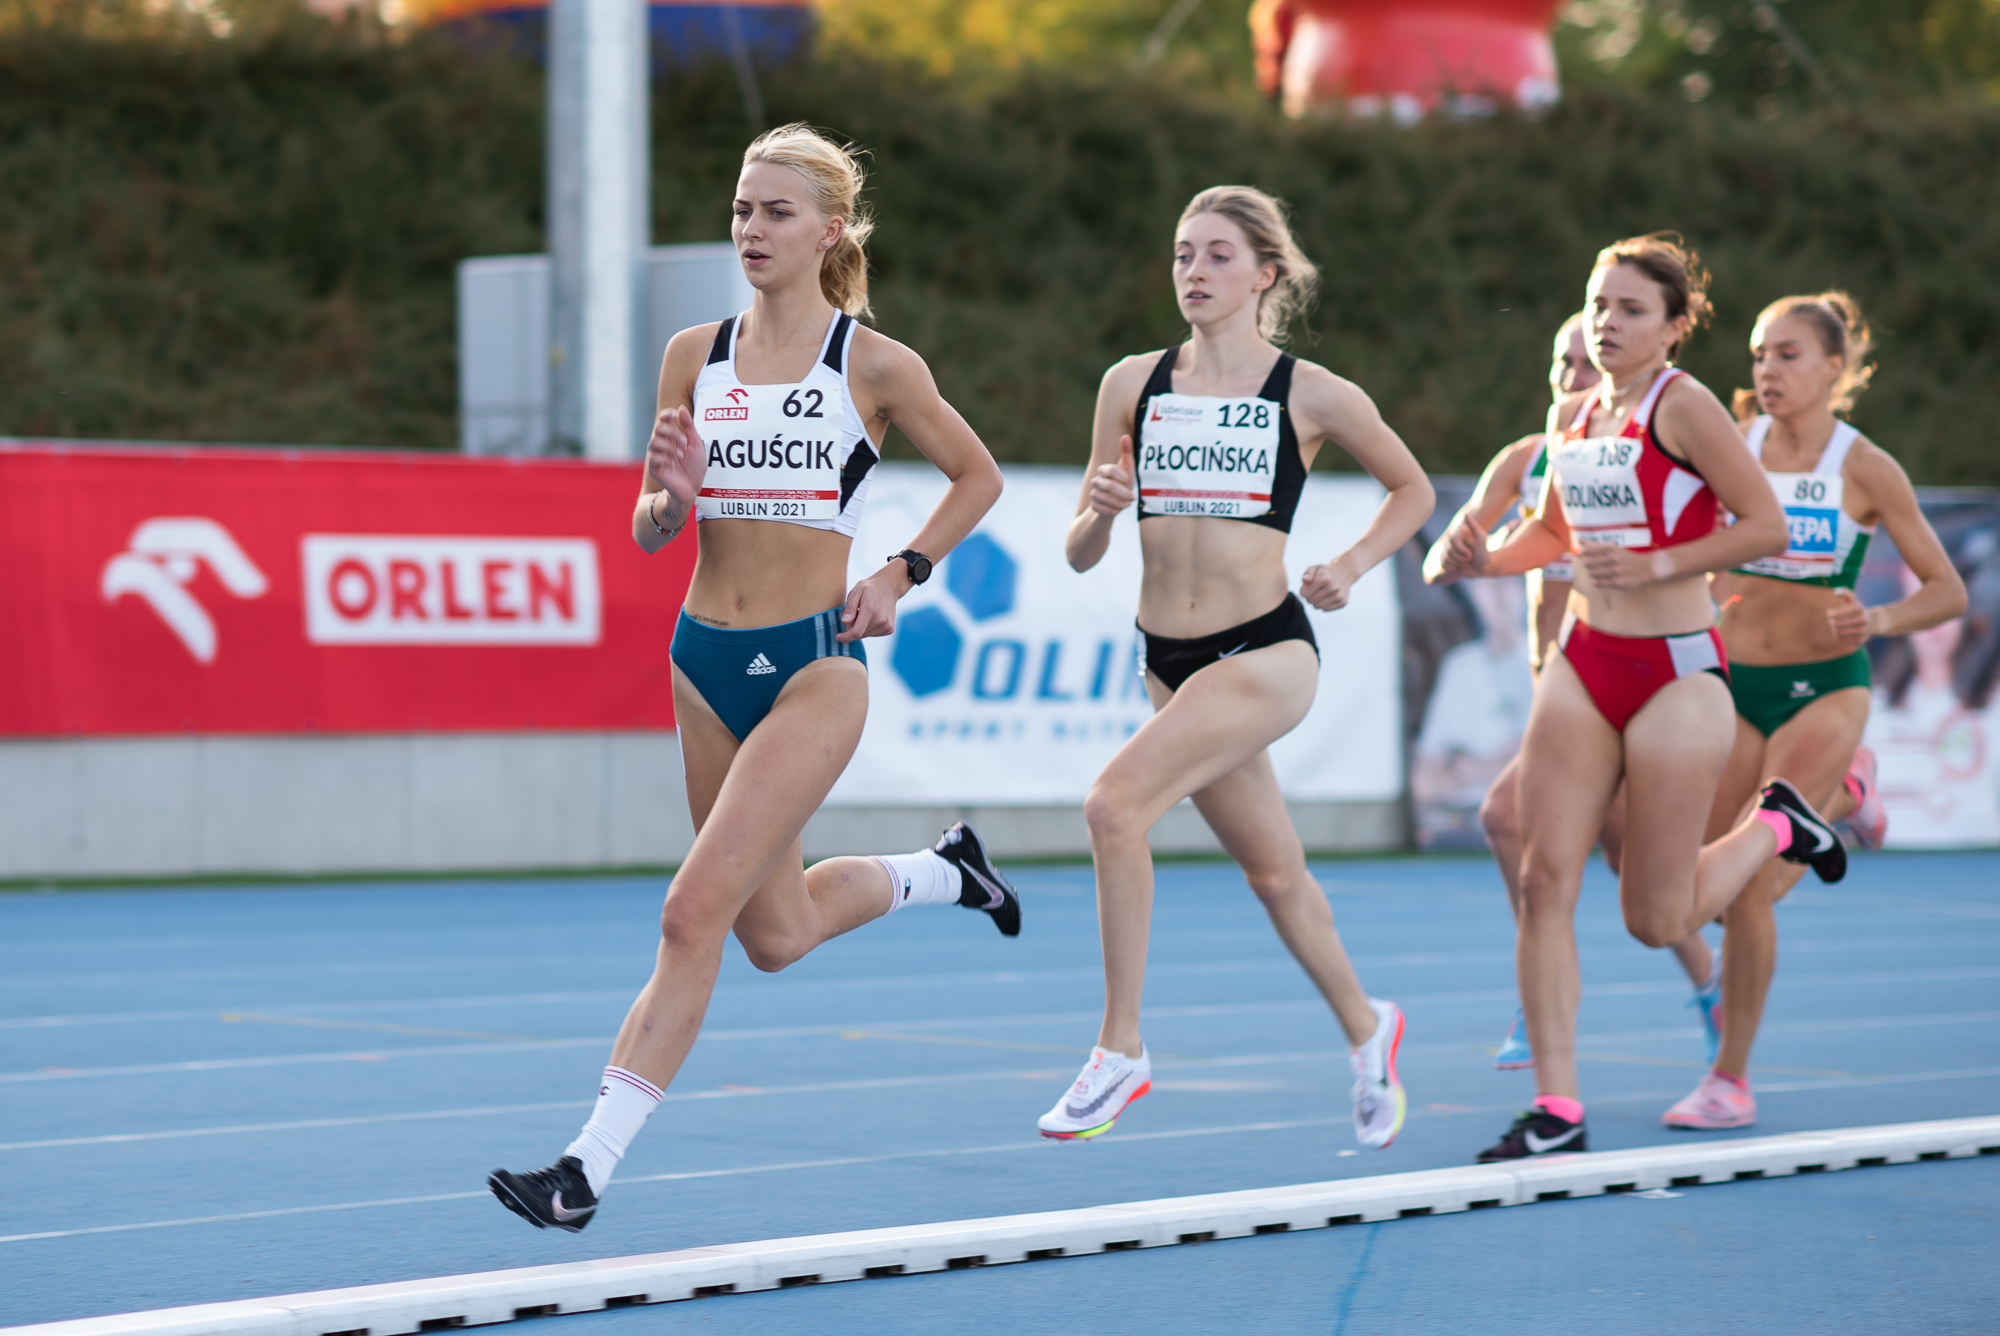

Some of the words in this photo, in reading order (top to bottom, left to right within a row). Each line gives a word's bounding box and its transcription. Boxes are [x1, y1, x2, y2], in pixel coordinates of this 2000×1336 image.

[706, 408, 747, 420] ORLEN
[783, 389, 824, 418] 62
[1218, 403, 1270, 428] 128
[702, 434, 834, 470] AGUŚCIK
[1144, 441, 1270, 475] PŁOCIŃSKA
[1795, 479, 1826, 502] 80
[720, 502, 768, 516] LUBLIN
[772, 502, 806, 516] 2021
[1164, 501, 1206, 513] LUBLIN
[1209, 502, 1241, 514] 2021
[327, 556, 575, 623] ORLEN
[746, 665, 777, 675] adidas
